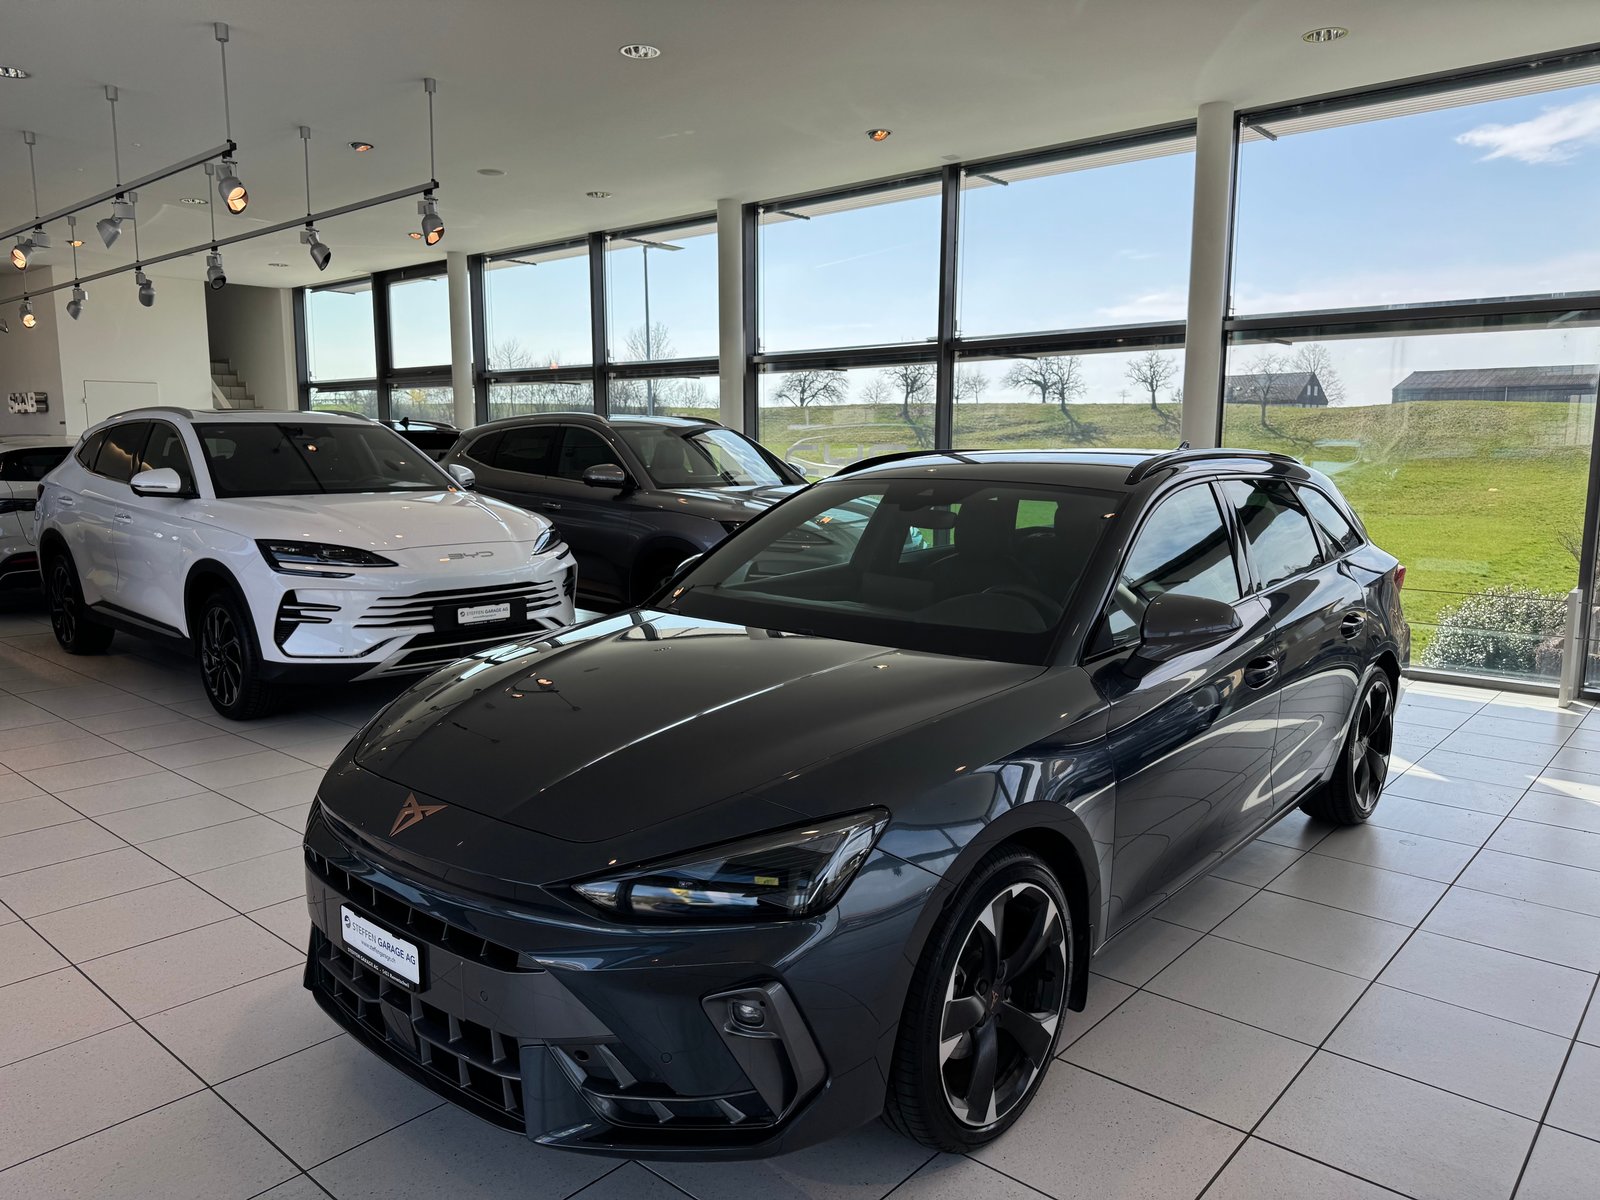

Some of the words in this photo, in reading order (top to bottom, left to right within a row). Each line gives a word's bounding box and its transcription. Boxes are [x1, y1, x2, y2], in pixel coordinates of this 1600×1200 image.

[448, 551, 494, 560] BYD
[352, 922, 377, 944] STEFFEN
[377, 937, 404, 960] GARAGE
[405, 952, 416, 966] AG
